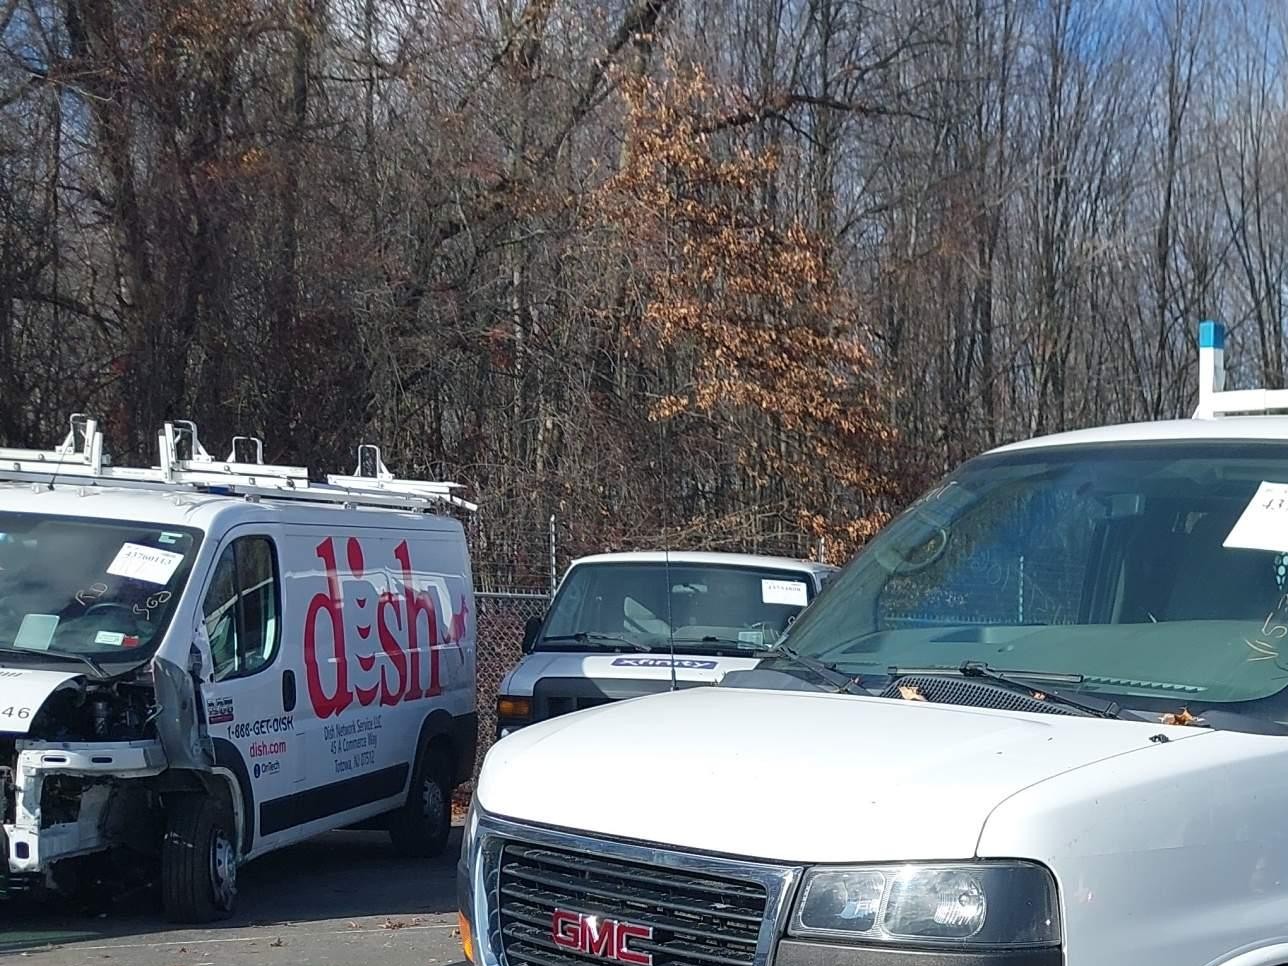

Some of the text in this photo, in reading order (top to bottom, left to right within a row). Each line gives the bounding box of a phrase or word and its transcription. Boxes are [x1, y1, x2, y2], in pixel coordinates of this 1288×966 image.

[304, 536, 443, 719] dish
[227, 716, 294, 739] 1-888-GET-DISH
[249, 741, 287, 758] dish.com
[552, 907, 653, 966] GMC
